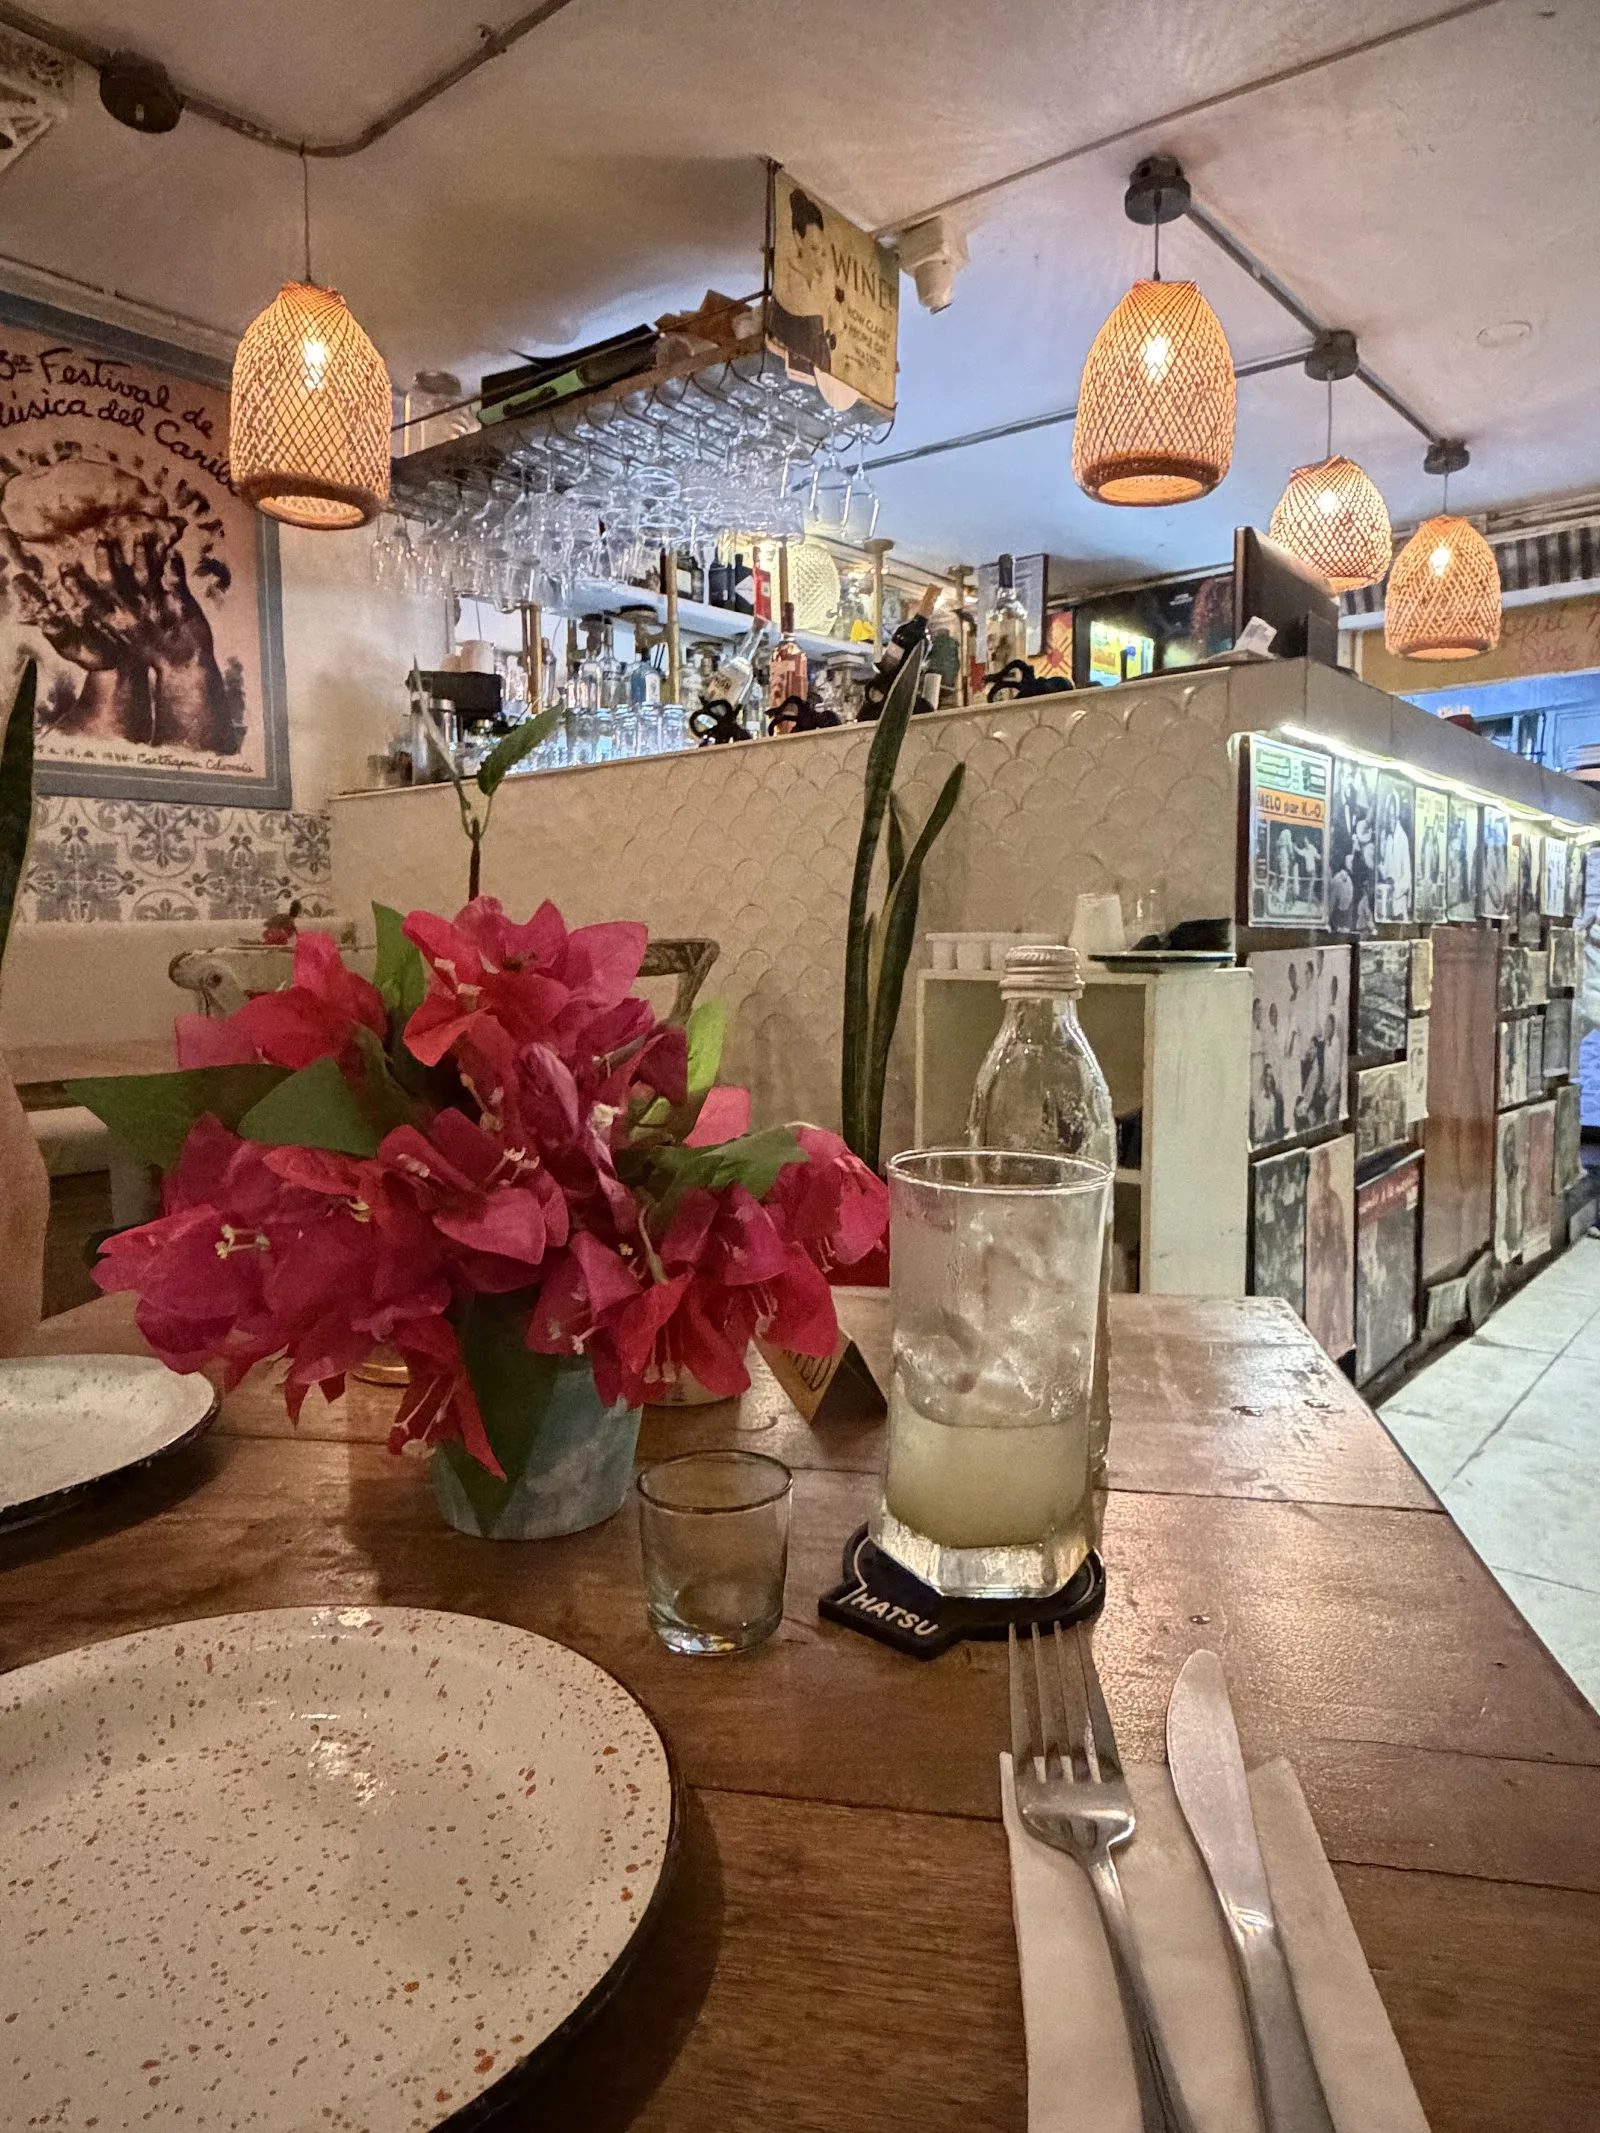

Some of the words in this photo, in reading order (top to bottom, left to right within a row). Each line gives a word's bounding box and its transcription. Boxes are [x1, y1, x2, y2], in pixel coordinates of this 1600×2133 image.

[0, 389, 94, 428] úsica
[98, 399, 145, 436] del
[38, 347, 173, 413] Festival
[182, 407, 214, 440] de
[850, 1592, 939, 1635] HATSU
